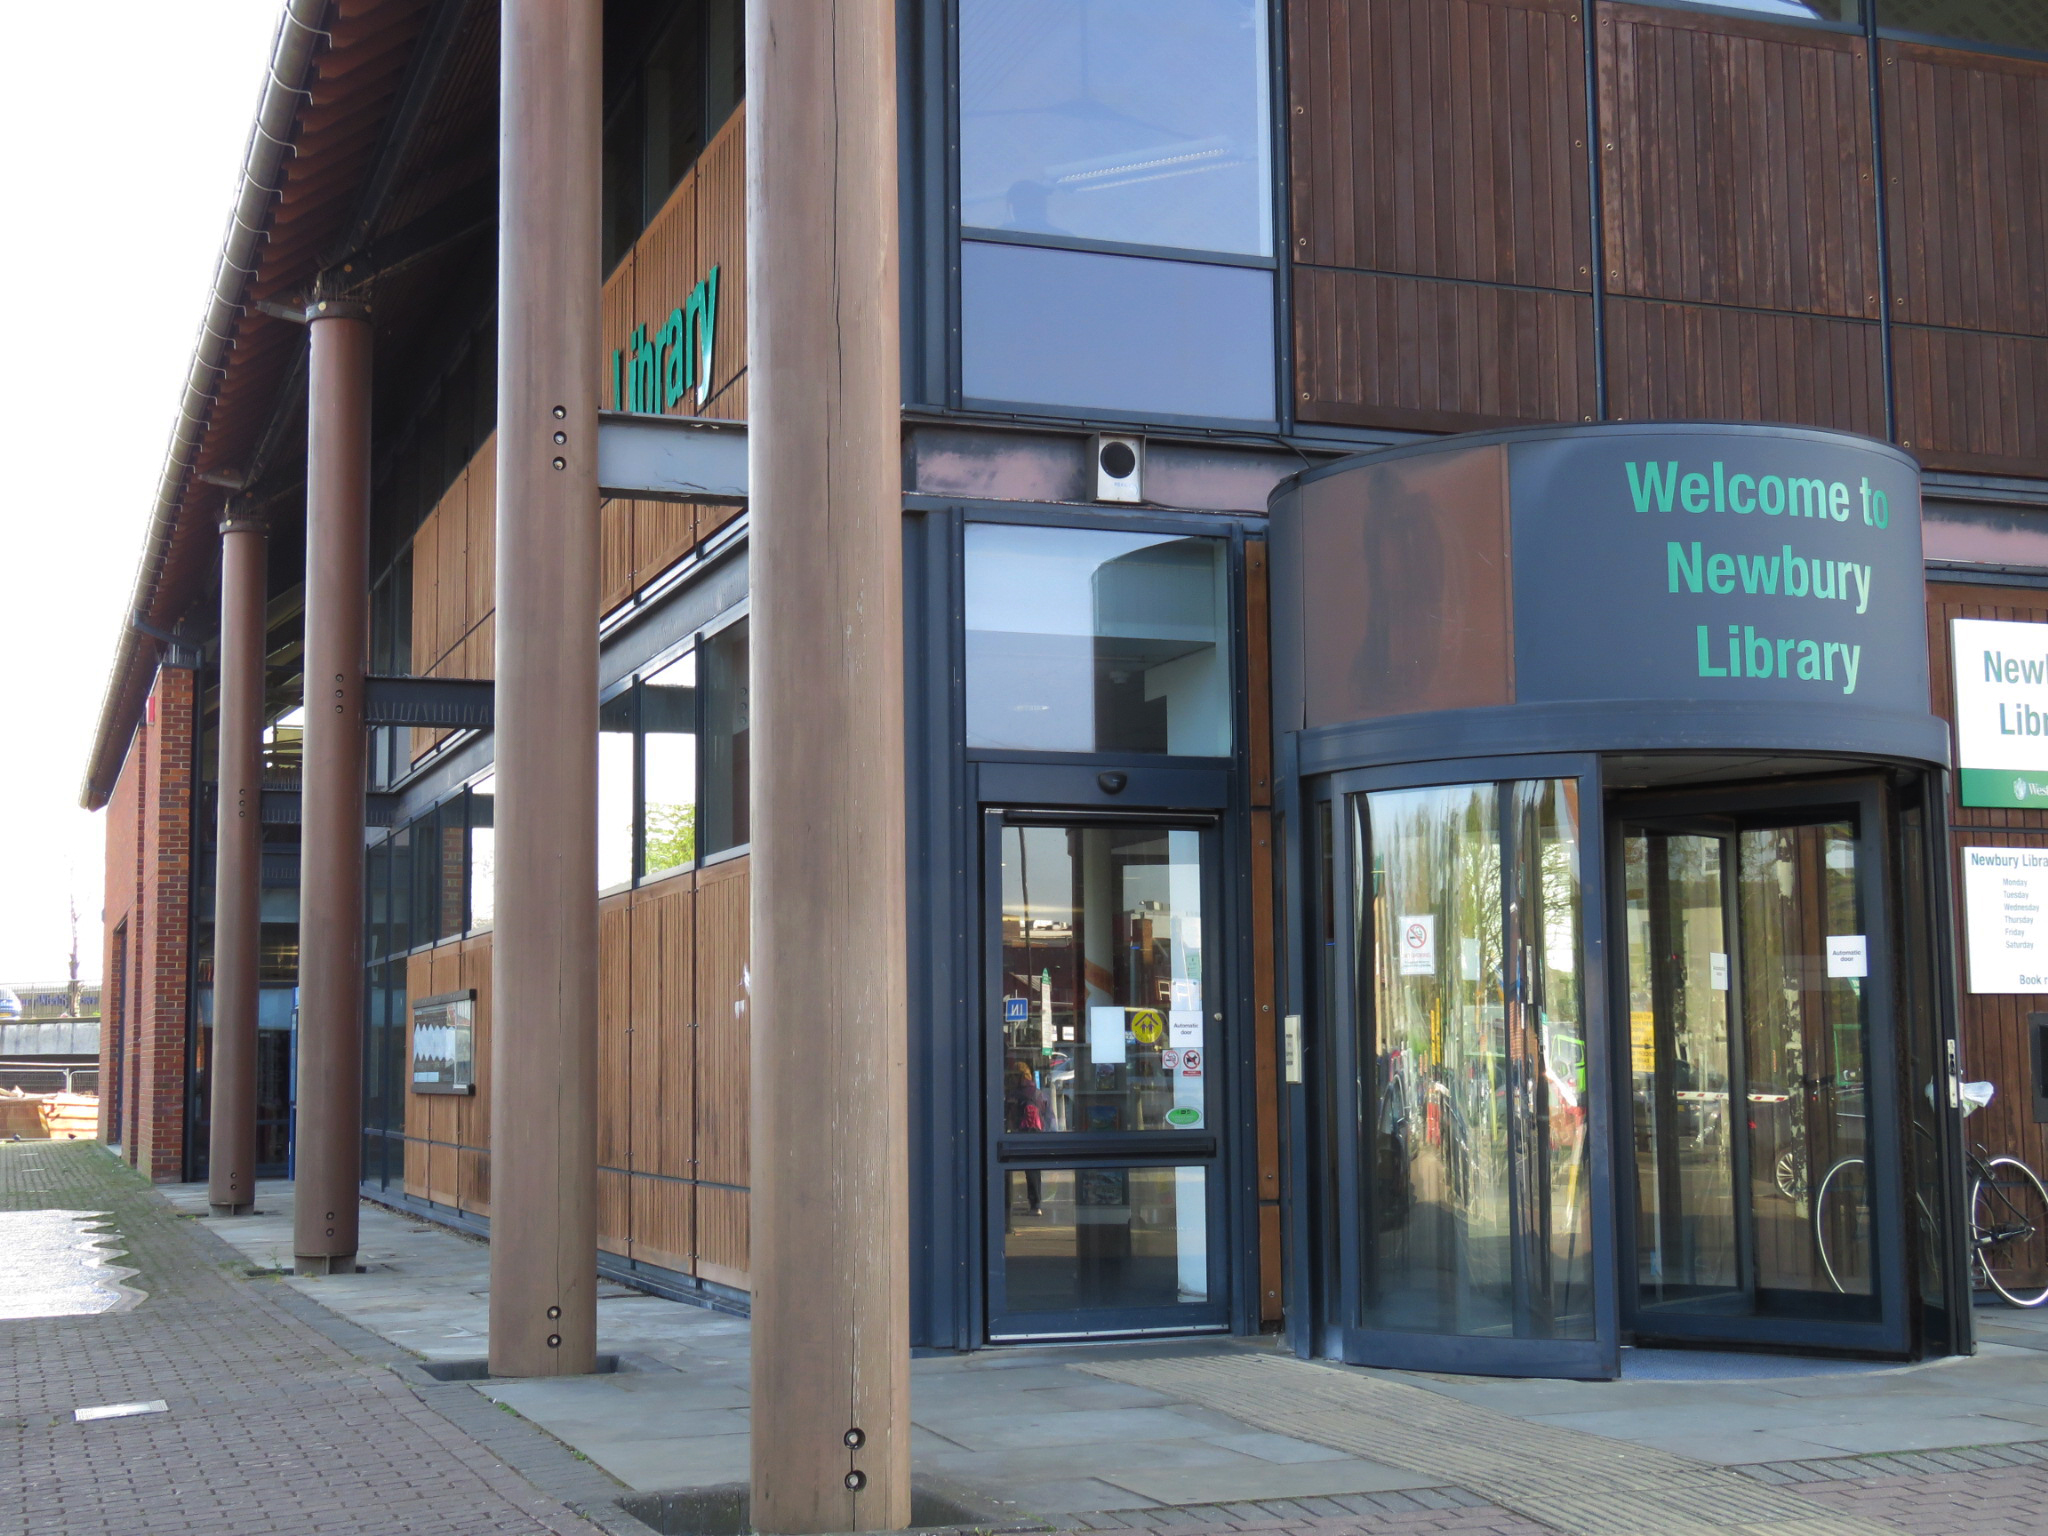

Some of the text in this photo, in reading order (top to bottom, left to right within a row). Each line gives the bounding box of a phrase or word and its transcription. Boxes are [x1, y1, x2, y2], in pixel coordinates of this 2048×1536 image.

[1625, 461, 1889, 529] Welcome to
[1667, 542, 1871, 614] Newbury
[1697, 625, 1861, 694] Library
[1971, 853, 2019, 869] Newbury
[2003, 878, 2027, 887] Monday
[2003, 891, 2029, 899] Tuesday
[2004, 903, 2039, 912] Wednesday
[2004, 916, 2034, 925] Thursday
[2005, 928, 2024, 937] Friday
[2005, 941, 2034, 950] Saturday
[2019, 974, 2042, 985] Book
